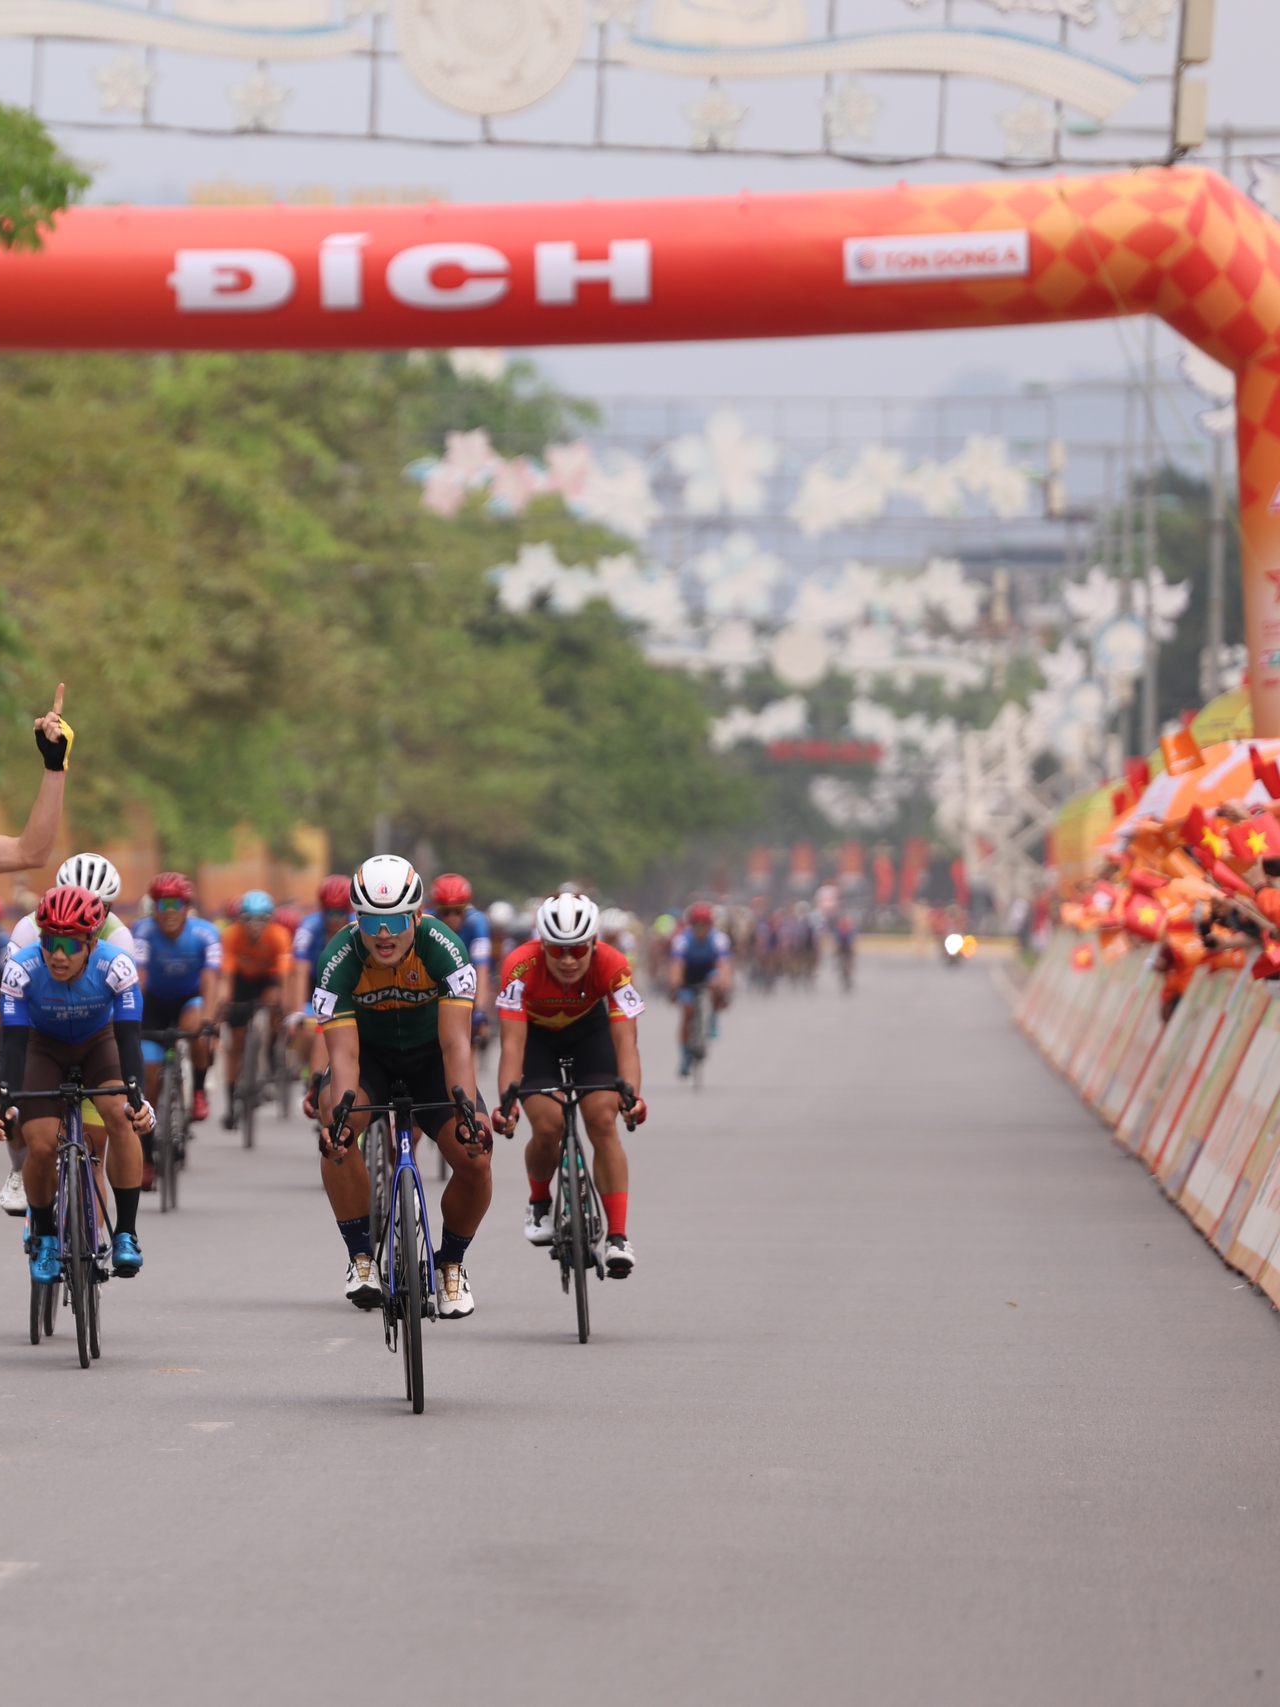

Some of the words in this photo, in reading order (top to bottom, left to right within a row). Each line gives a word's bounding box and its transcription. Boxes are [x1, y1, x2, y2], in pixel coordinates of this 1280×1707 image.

[166, 233, 653, 311] ĐÍCH
[22, 957, 41, 971] CITY
[111, 960, 132, 983] 13
[2, 967, 22, 987] 13
